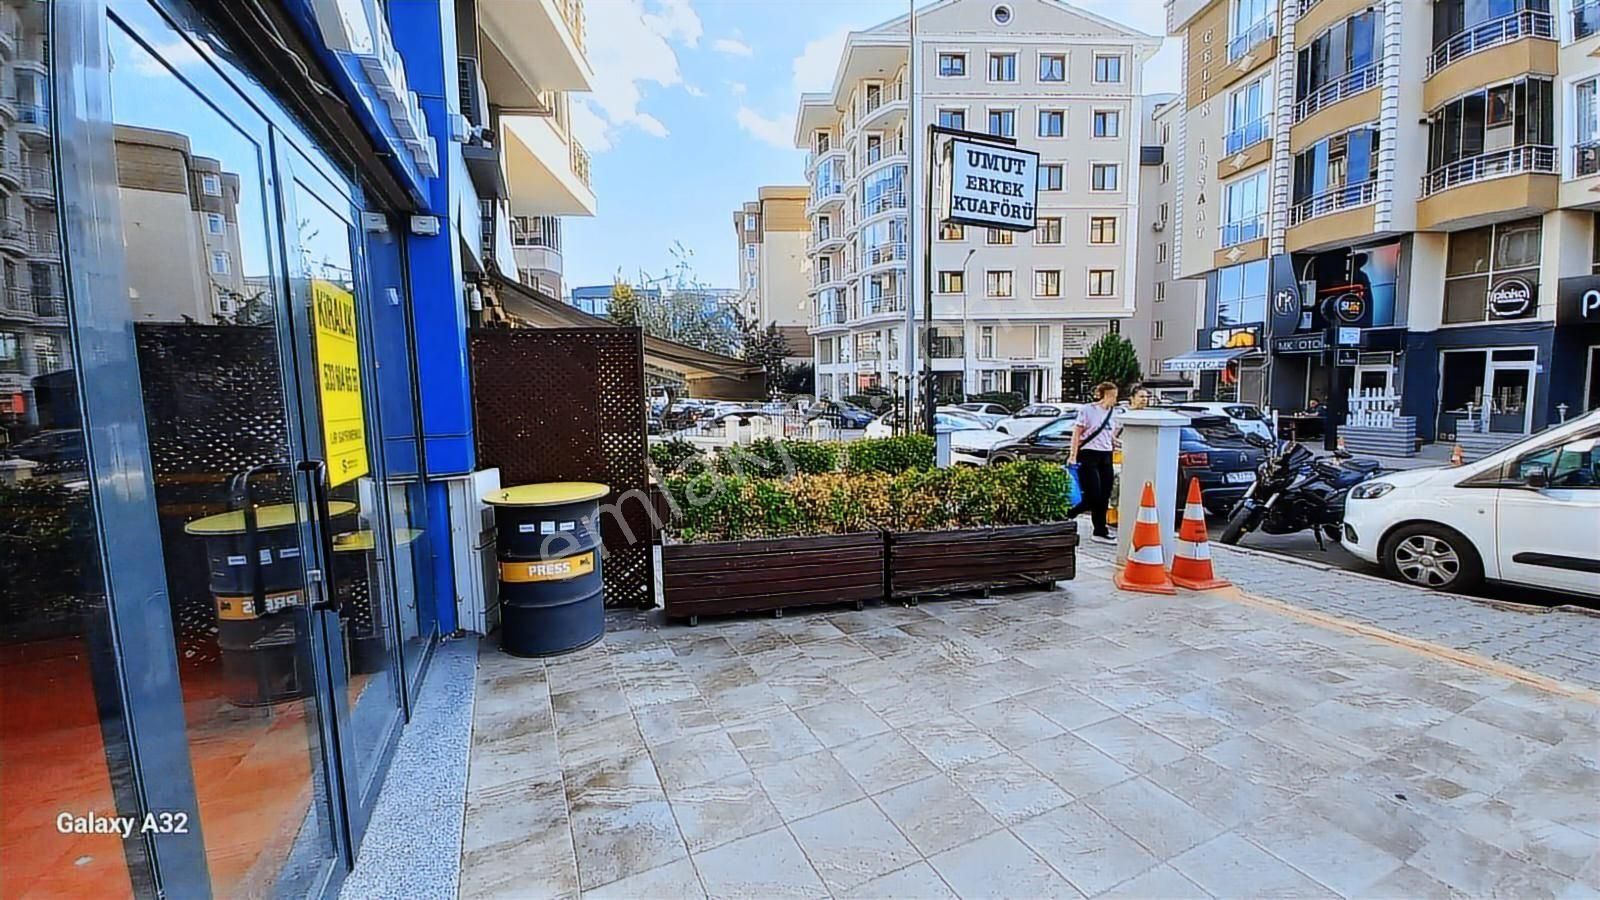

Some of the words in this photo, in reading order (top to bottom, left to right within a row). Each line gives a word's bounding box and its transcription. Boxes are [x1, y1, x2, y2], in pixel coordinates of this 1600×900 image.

[966, 149, 1026, 175] UMUT
[965, 174, 1024, 198] ERKEK
[952, 195, 1034, 221] KUAFÖRÜ
[528, 561, 571, 577] PRESS
